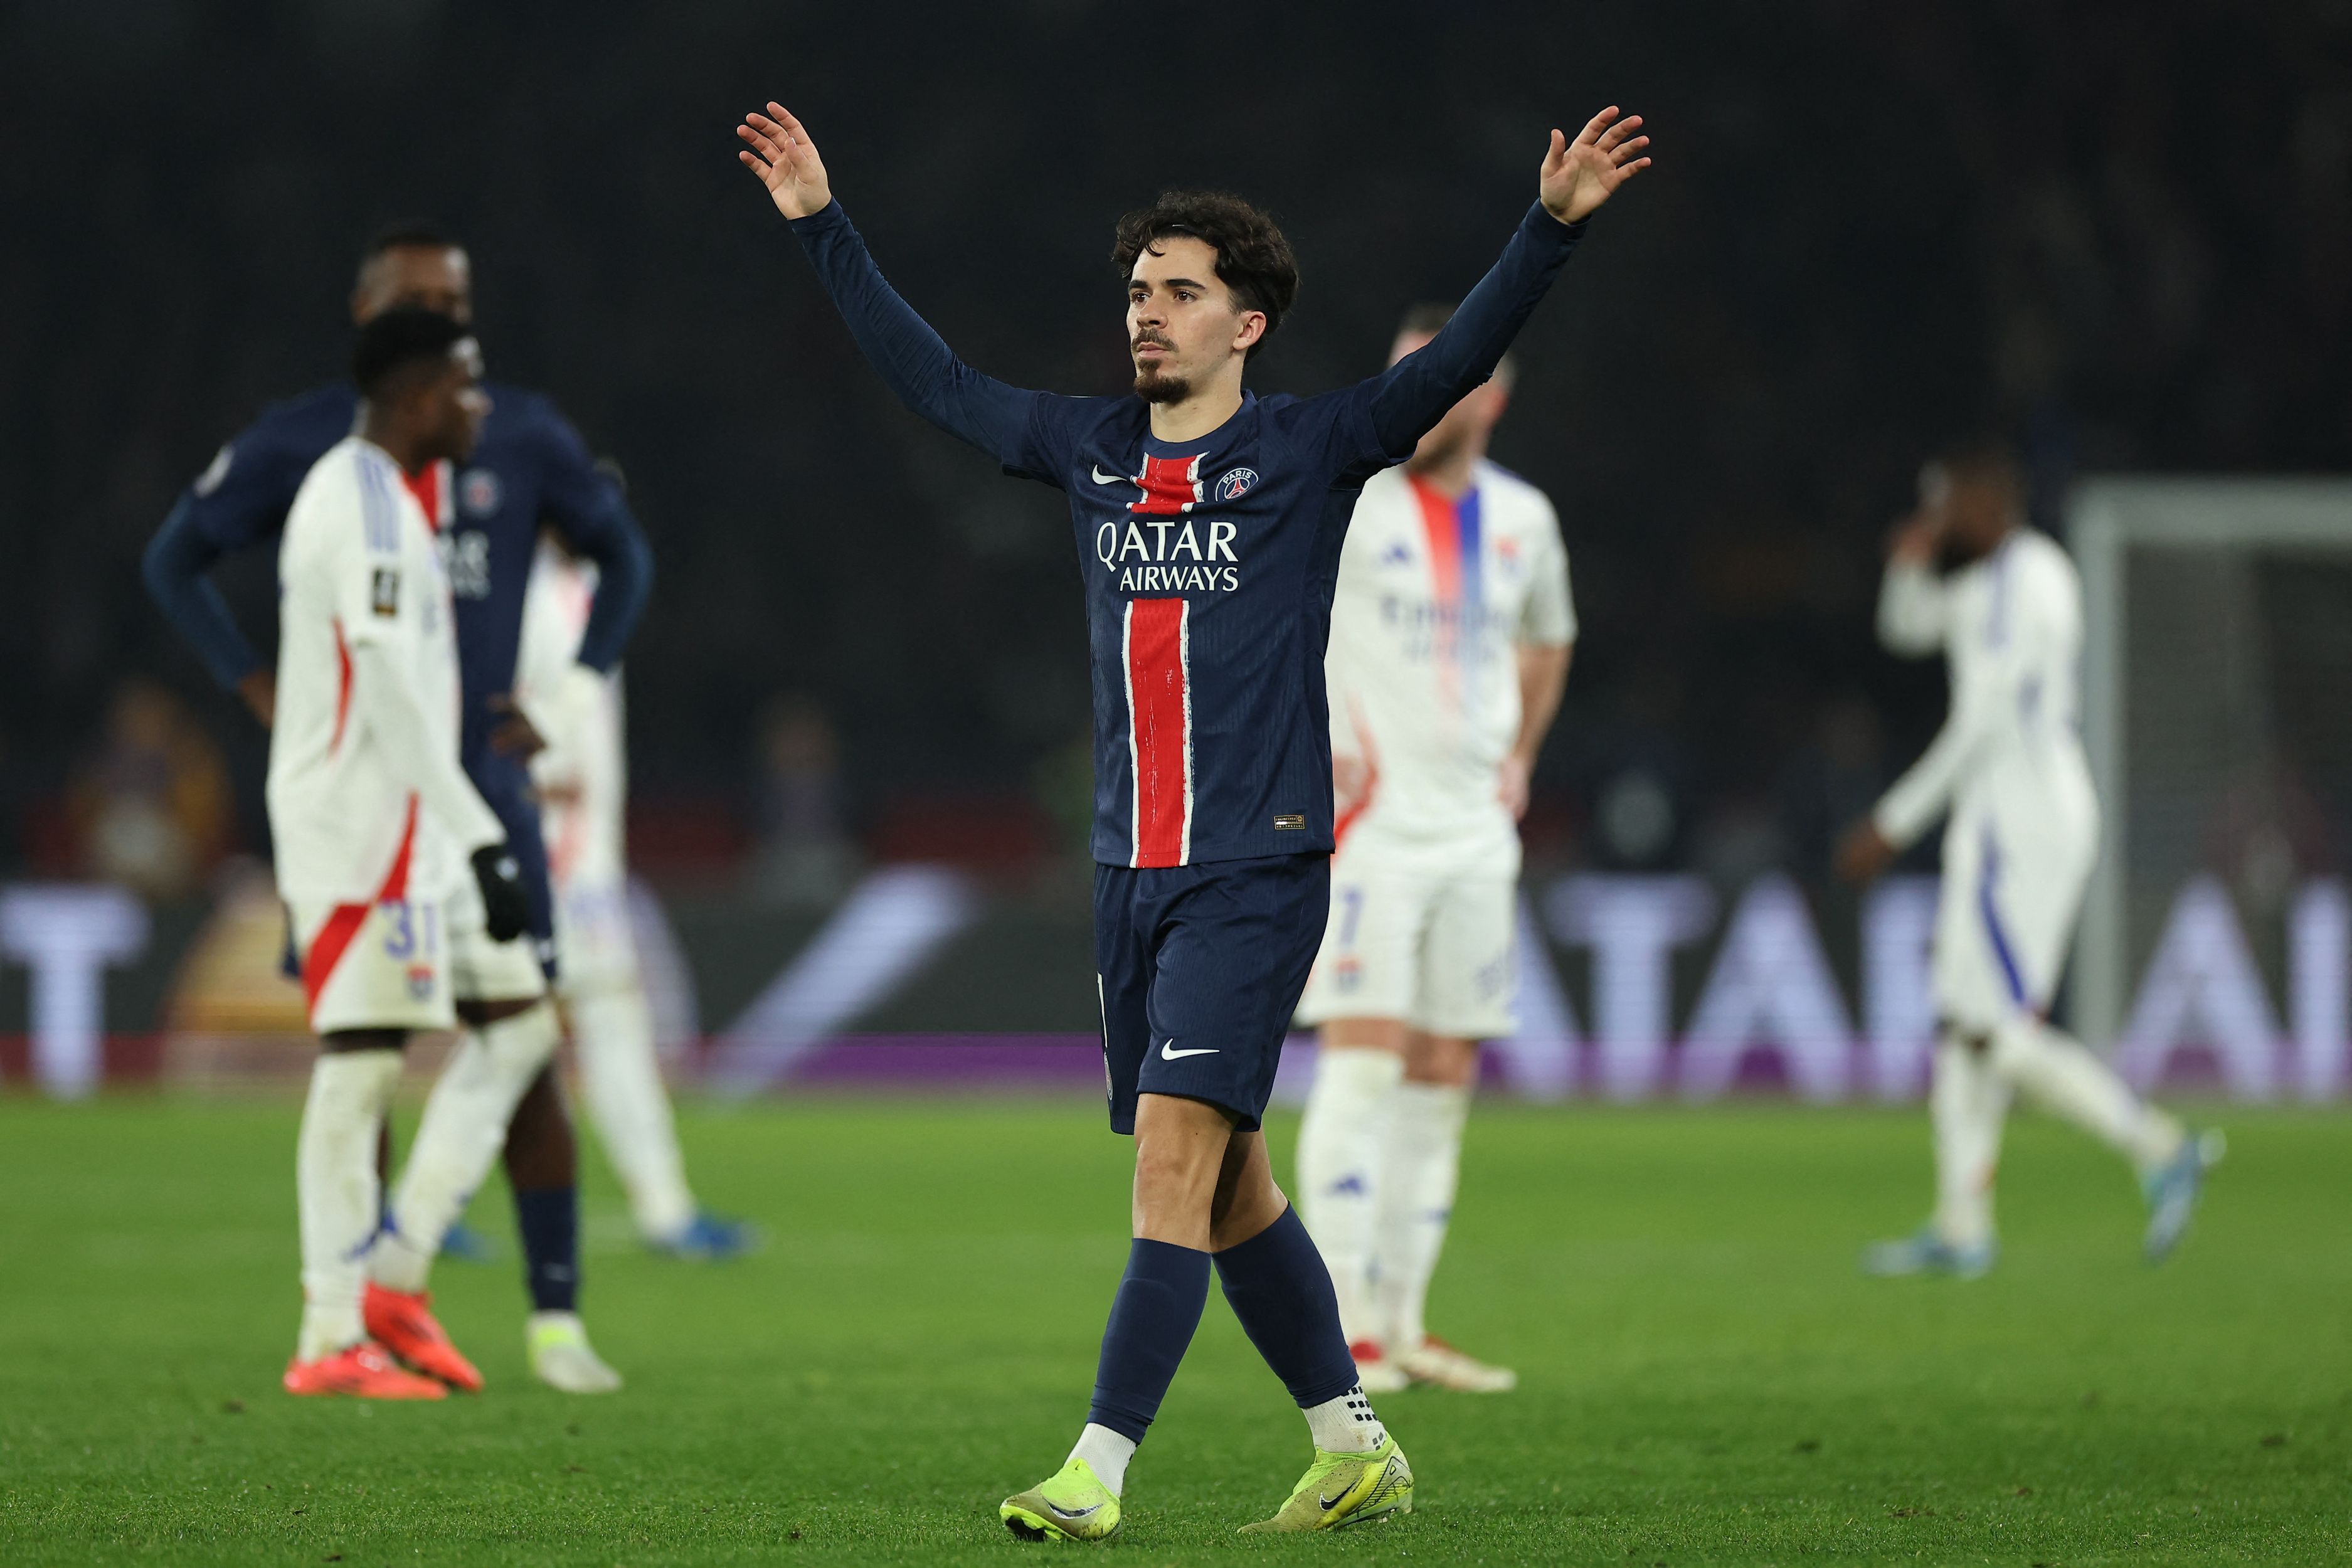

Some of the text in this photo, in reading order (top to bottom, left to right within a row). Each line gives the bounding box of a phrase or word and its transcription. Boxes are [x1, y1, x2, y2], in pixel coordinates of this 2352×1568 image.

[1222, 470, 1253, 484] PARIS
[1096, 521, 1239, 573] QATAR
[1120, 566, 1239, 591] AIRWAYS
[381, 897, 438, 960] 31
